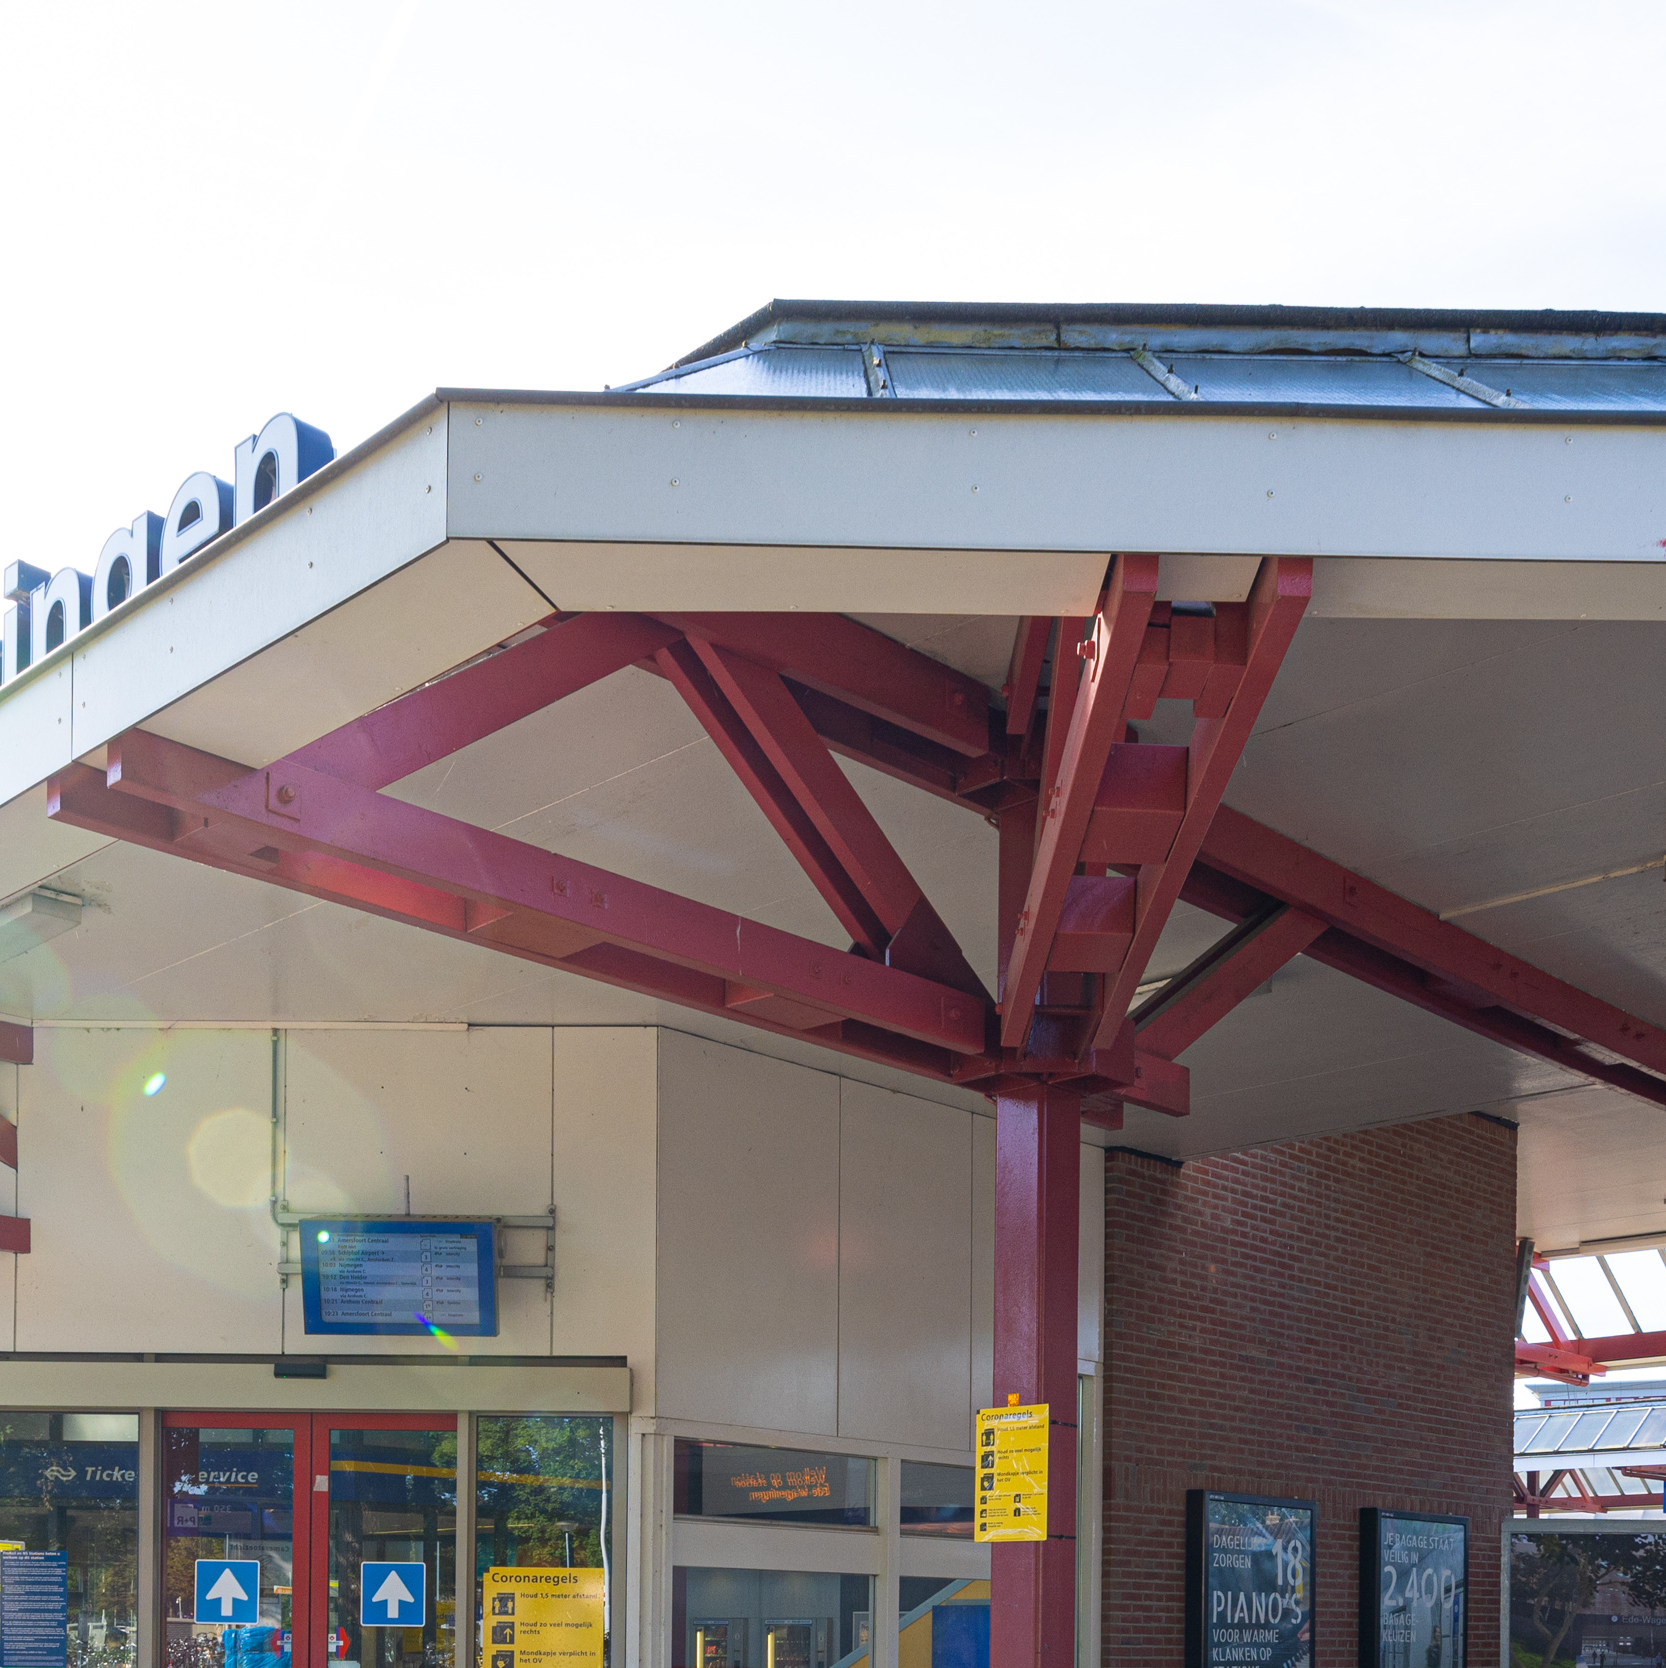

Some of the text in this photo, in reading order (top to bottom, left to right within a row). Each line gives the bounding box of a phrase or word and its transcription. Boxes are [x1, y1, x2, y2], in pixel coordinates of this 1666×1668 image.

[981, 1409, 1033, 1422] Coronaregels
[85, 1466, 259, 1484] Ticke ervice
[1383, 1532, 1454, 1551] JE BAGAGE STAAT
[1213, 1552, 1252, 1569] ZORGEN
[1271, 1538, 1304, 1587] 18
[1383, 1549, 1419, 1564] VEILIG IN
[492, 1572, 579, 1586] Coronaregels
[540, 1592, 549, 1600] 1,5
[1212, 1590, 1302, 1625] PIANO'S
[1212, 1629, 1279, 1643] VOOR WARME
[519, 1649, 557, 1657] Mondkapje
[558, 1650, 588, 1658] verplicht
[1212, 1646, 1272, 1662] KLANKEN OP
